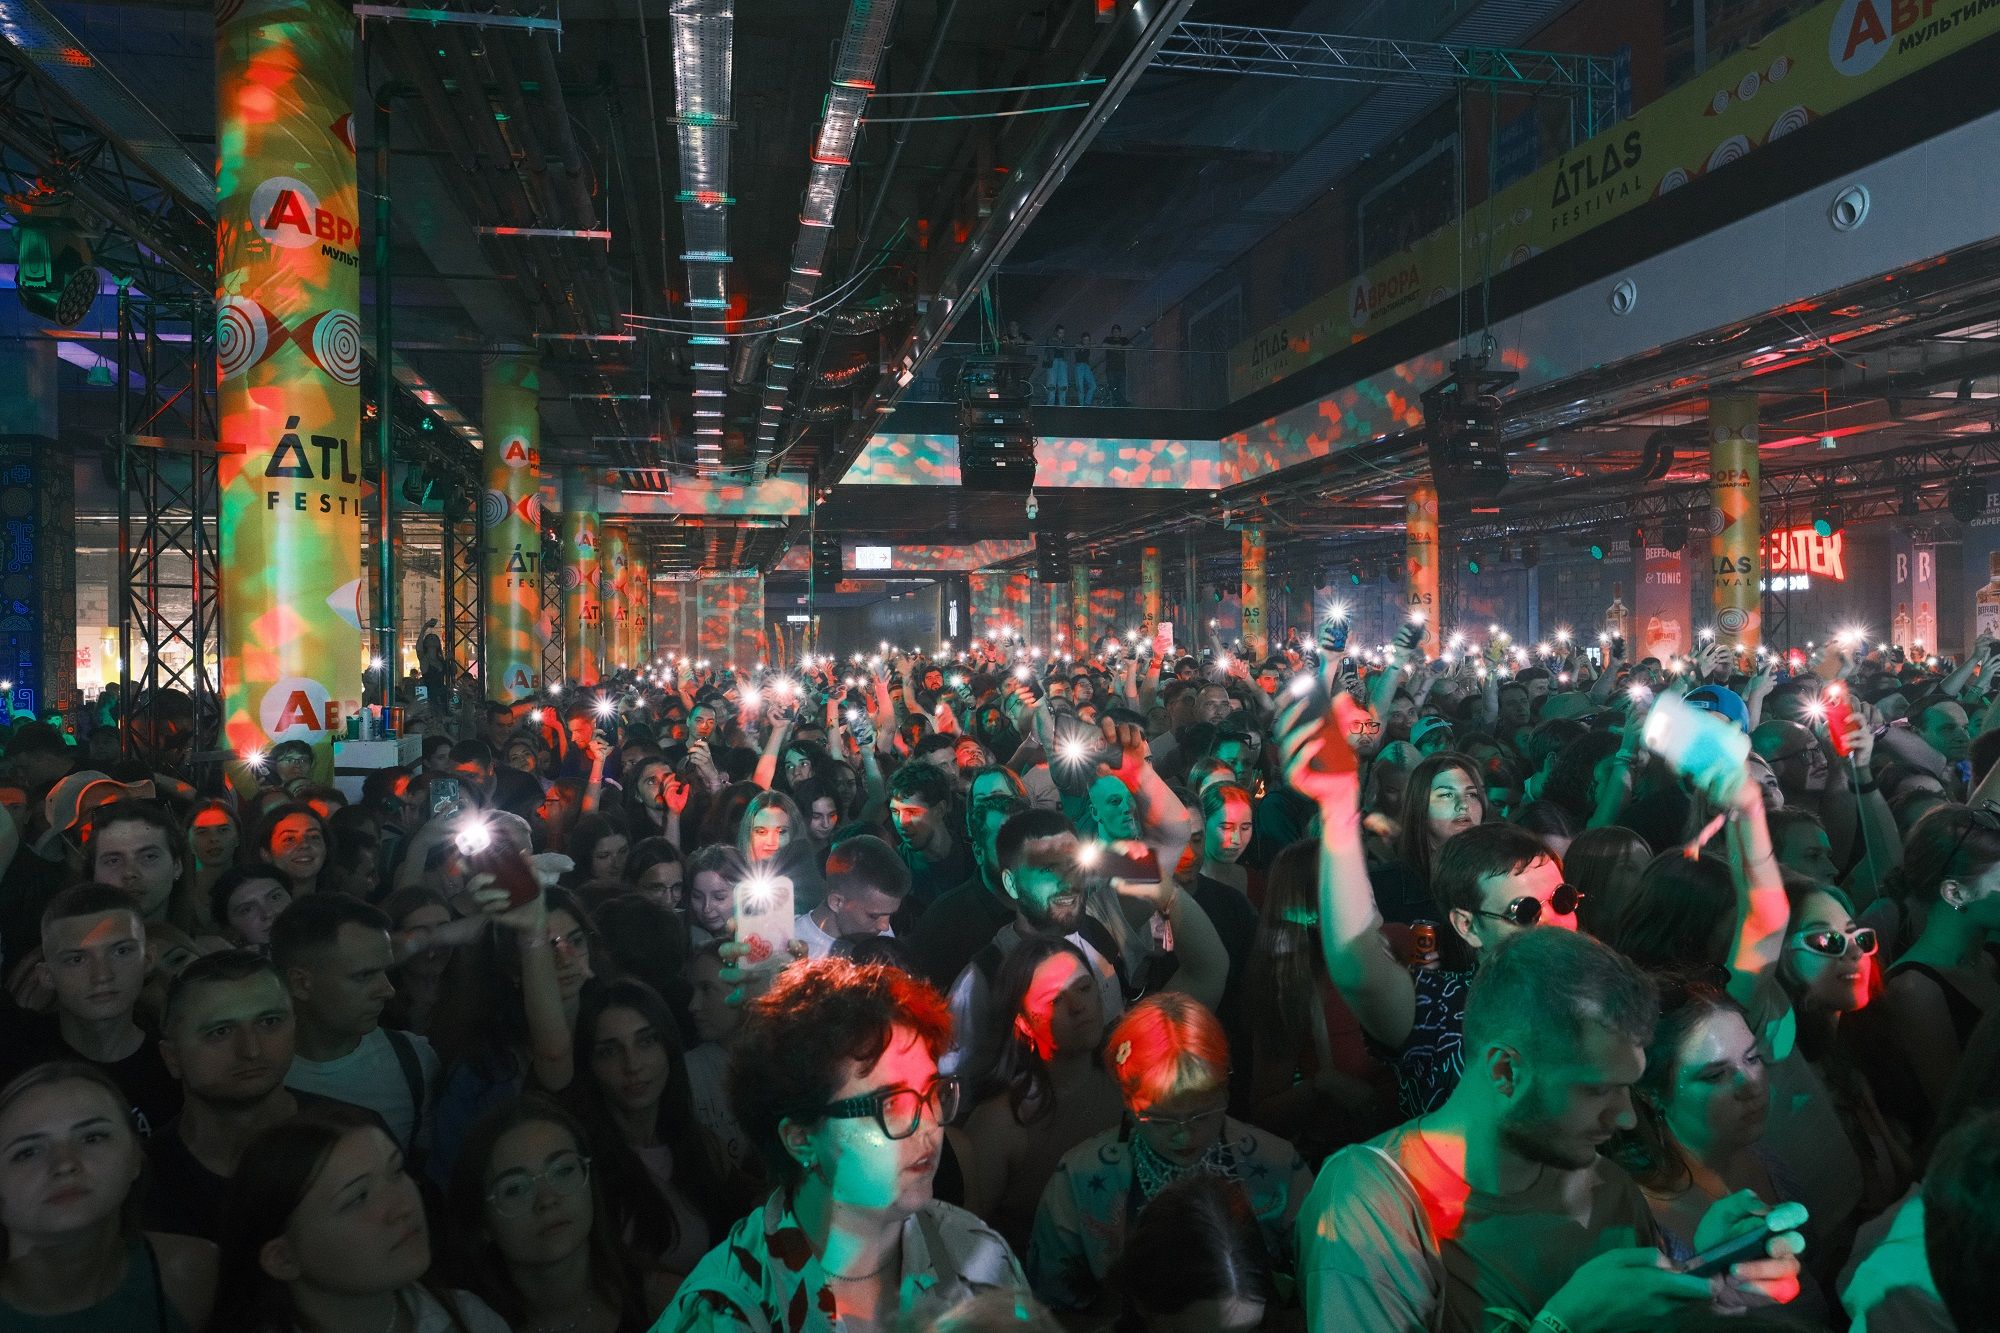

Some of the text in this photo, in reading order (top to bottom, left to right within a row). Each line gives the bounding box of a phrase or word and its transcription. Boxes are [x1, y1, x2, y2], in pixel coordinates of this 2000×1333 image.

[1842, 0, 1935, 62] АВ
[1551, 175, 1642, 232] FESTIVAL
[267, 491, 359, 517] FESTI
[1656, 572, 1681, 585] TONIC
